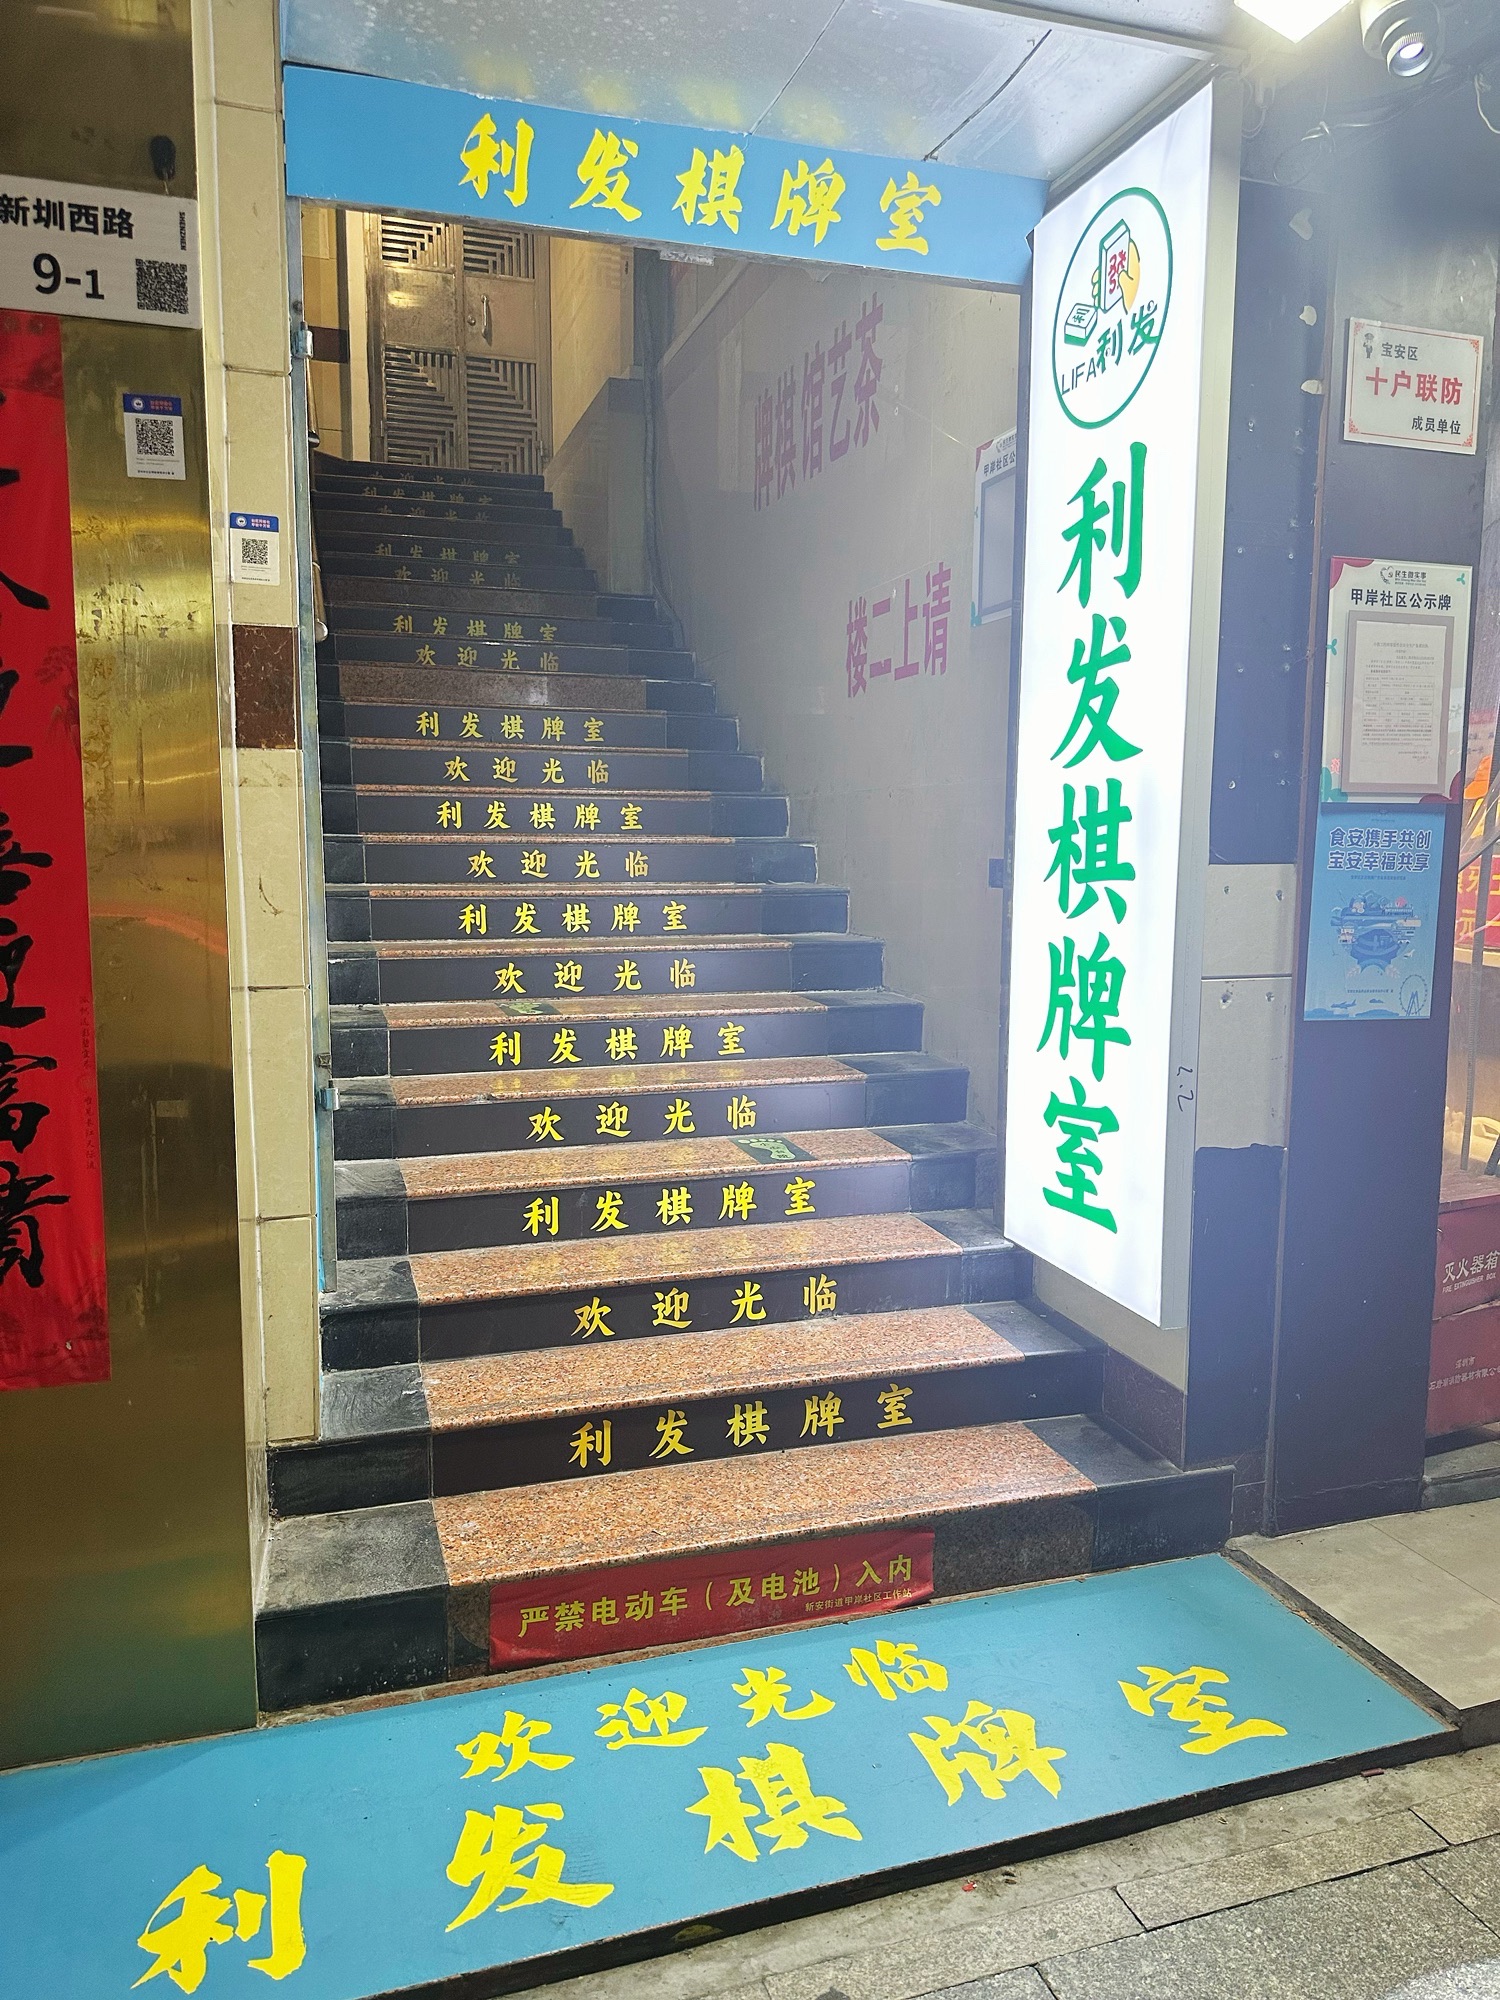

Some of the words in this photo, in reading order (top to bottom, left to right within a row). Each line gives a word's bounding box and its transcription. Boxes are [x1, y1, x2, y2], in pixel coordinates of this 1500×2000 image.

[459, 113, 941, 256] 利发棋牌室
[0, 193, 134, 240] 新圳西路
[33, 253, 105, 300] 9-1
[1096, 299, 1160, 375] 利发
[1381, 342, 1419, 361] 宝安区
[1061, 357, 1097, 396] LIFA
[1365, 367, 1463, 405] 十户联防
[1411, 416, 1461, 435] 成员单位
[1351, 589, 1452, 611] 甲岸社区公示牌
[394, 615, 557, 641] 利发棋牌室
[415, 644, 559, 672] 欢迎光临
[416, 711, 605, 742] 利发棋牌室
[443, 757, 610, 784] 欢迎光临
[436, 800, 643, 831] 利发棋牌室
[1036, 441, 1147, 1234] 利发棋牌室
[1330, 827, 1432, 850] 食安携手共创
[466, 850, 649, 878] 欢迎光临
[1327, 851, 1430, 872] 宝安幸福共享
[458, 901, 688, 935] 利发棋牌室
[494, 958, 697, 994] 欢迎光临
[489, 1021, 746, 1066] 利发棋牌室
[526, 1094, 757, 1142] 欢迎光临
[522, 1176, 816, 1236] 利发棋牌室
[1442, 1250, 1500, 1283] 灭火器箱
[571, 1273, 837, 1339] 欢迎光临
[568, 1383, 913, 1468] 利发棋牌室
[805, 1588, 913, 1612] 新安街道甲岸社区工作站
[455, 1640, 949, 1782] 欢迎光临
[136, 1664, 1289, 1994] 利发棋牌室
